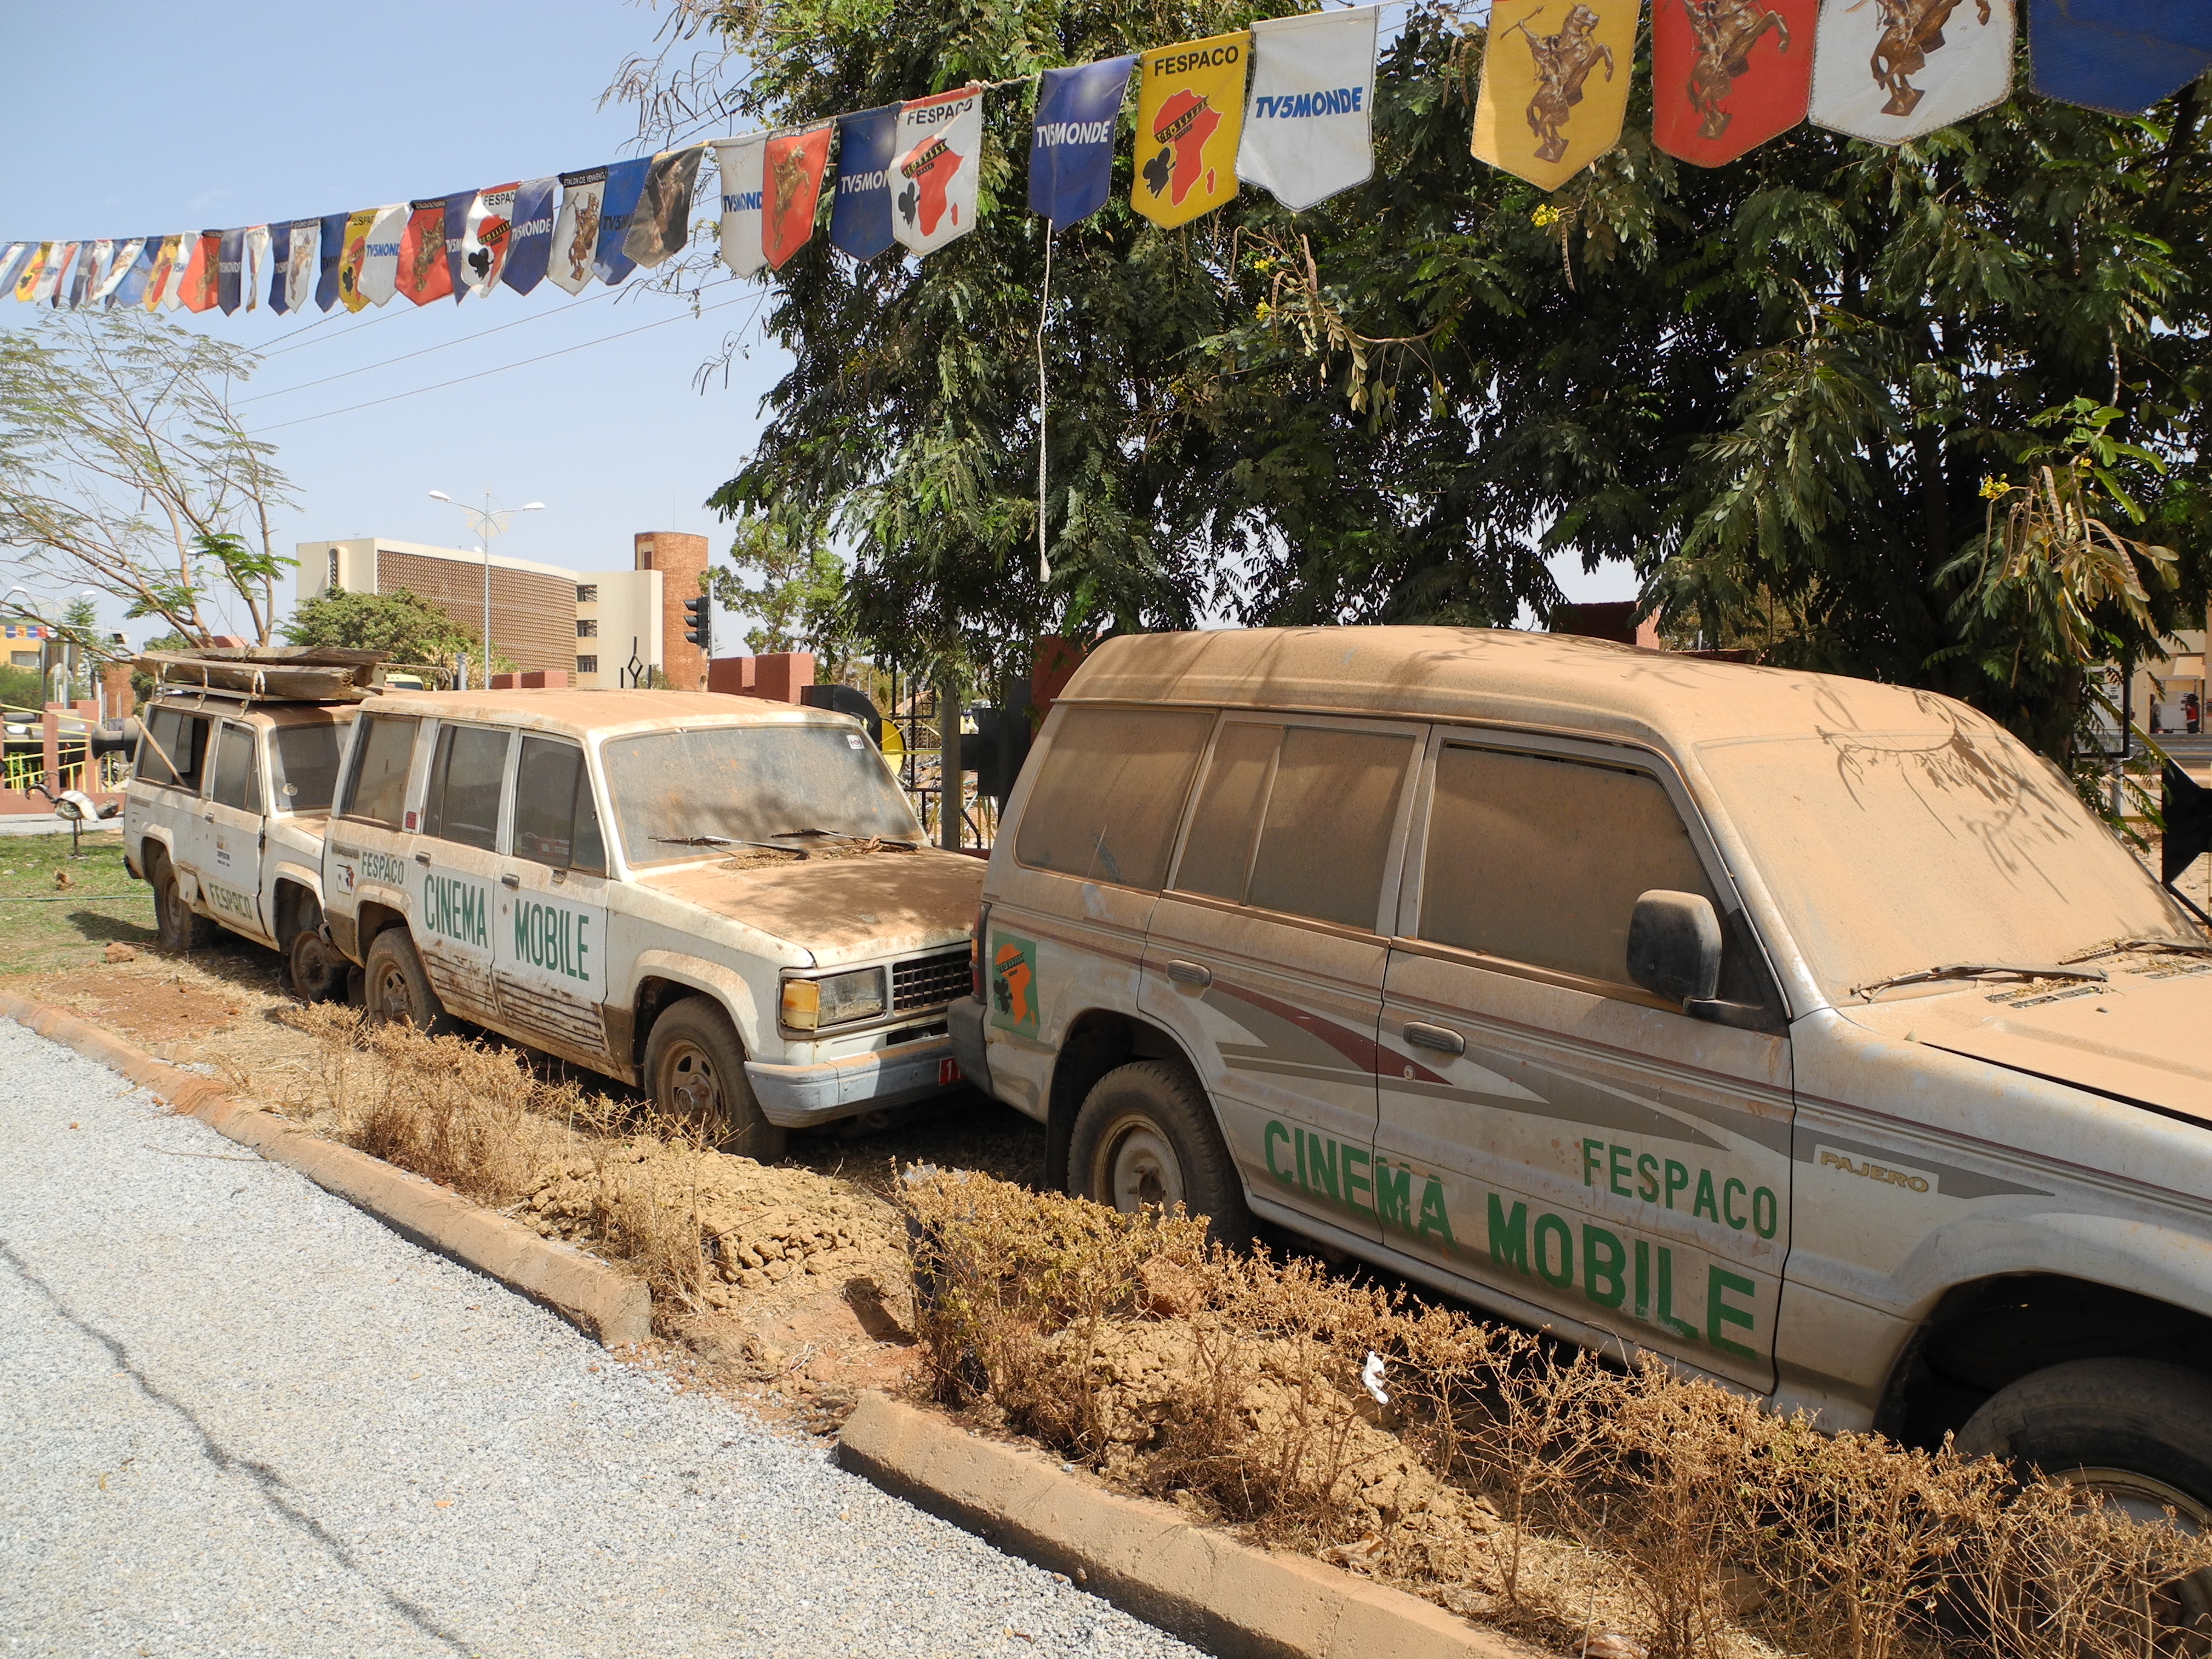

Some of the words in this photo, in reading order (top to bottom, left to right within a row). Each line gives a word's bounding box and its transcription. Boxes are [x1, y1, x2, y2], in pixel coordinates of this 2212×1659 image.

[1154, 45, 1239, 76] FESPACO
[907, 98, 973, 126] FESPACO
[1256, 86, 1363, 119] TV5MONDE
[1036, 121, 1111, 148] TV5MONDE
[579, 175, 586, 184] DE
[723, 191, 763, 213] TV5MOND
[511, 218, 552, 243] TV5MONDE
[361, 851, 404, 885] FESPACO
[208, 882, 253, 920] FESPACO
[424, 873, 489, 950] CINEMA
[514, 898, 590, 982] MOBILE
[1820, 1150, 1929, 1193] PAJERO
[1583, 1138, 1778, 1240] FESPACO
[1263, 1119, 1456, 1250] CINEMA
[1486, 1191, 1758, 1362] MOBILE
